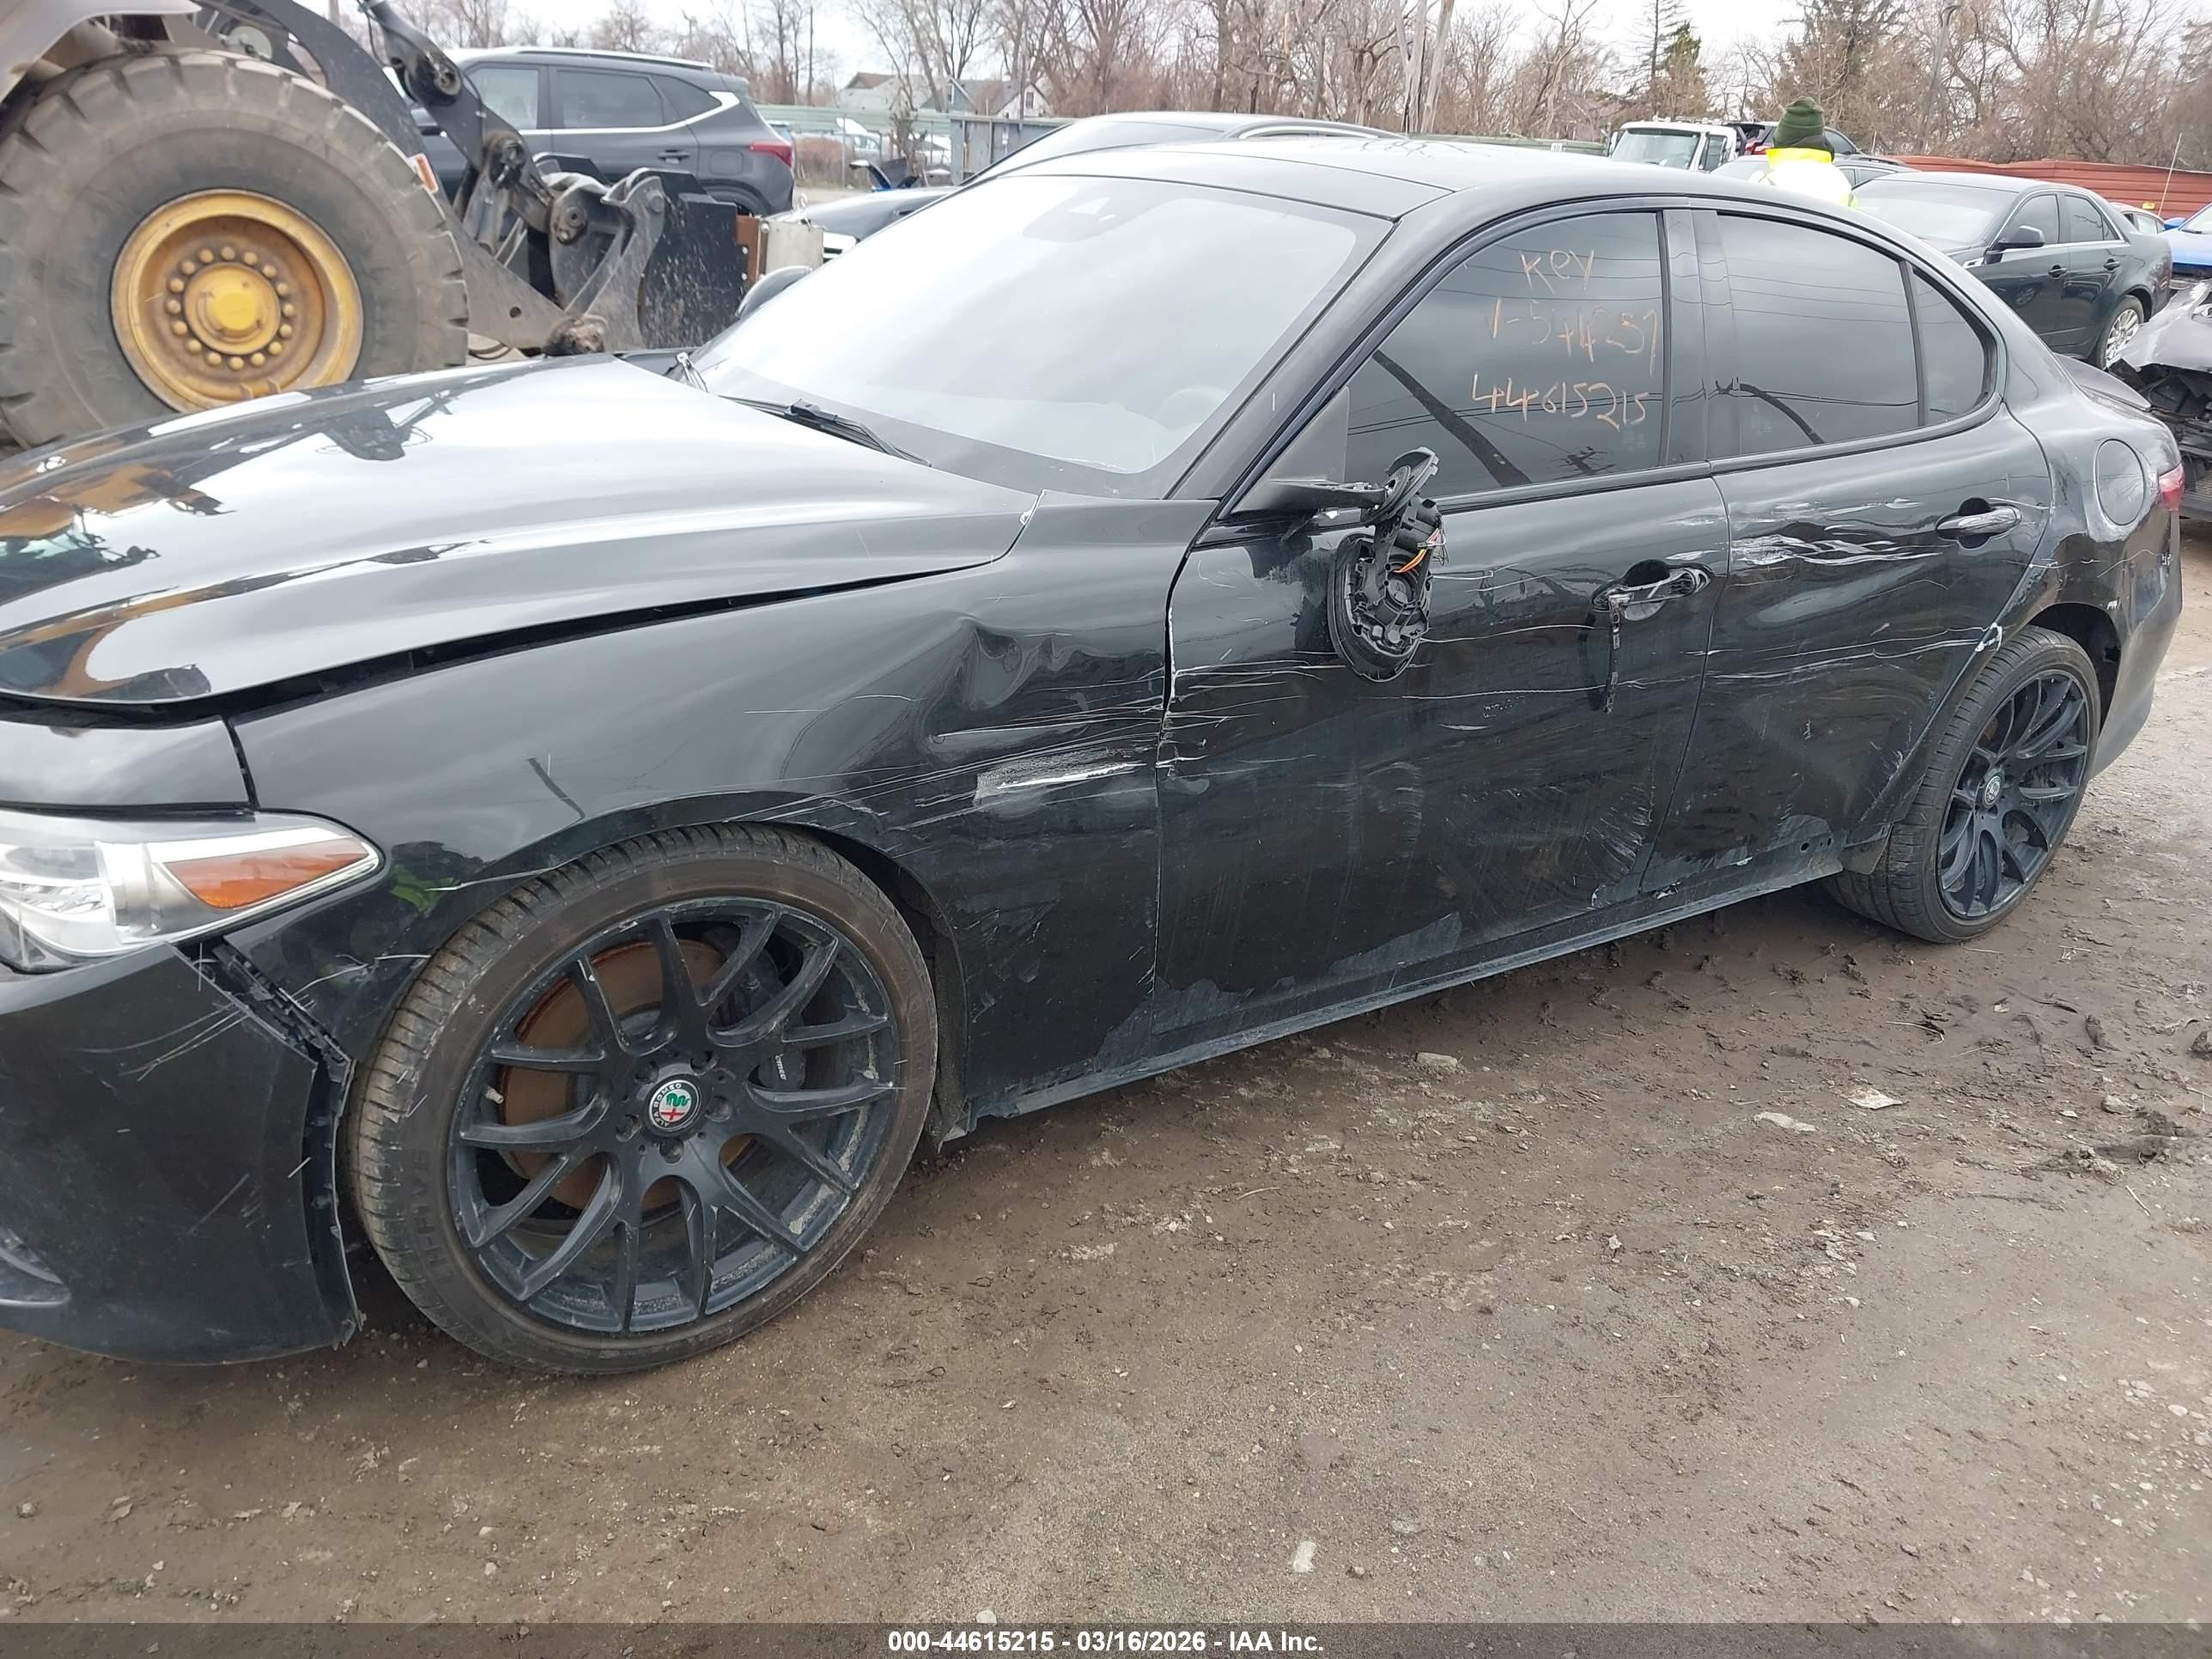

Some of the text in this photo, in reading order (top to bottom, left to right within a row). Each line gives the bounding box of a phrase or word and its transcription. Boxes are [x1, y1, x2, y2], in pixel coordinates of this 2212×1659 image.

[1471, 372, 1650, 432] 44615215
[653, 1083, 683, 1127] ALFA ROMEO
